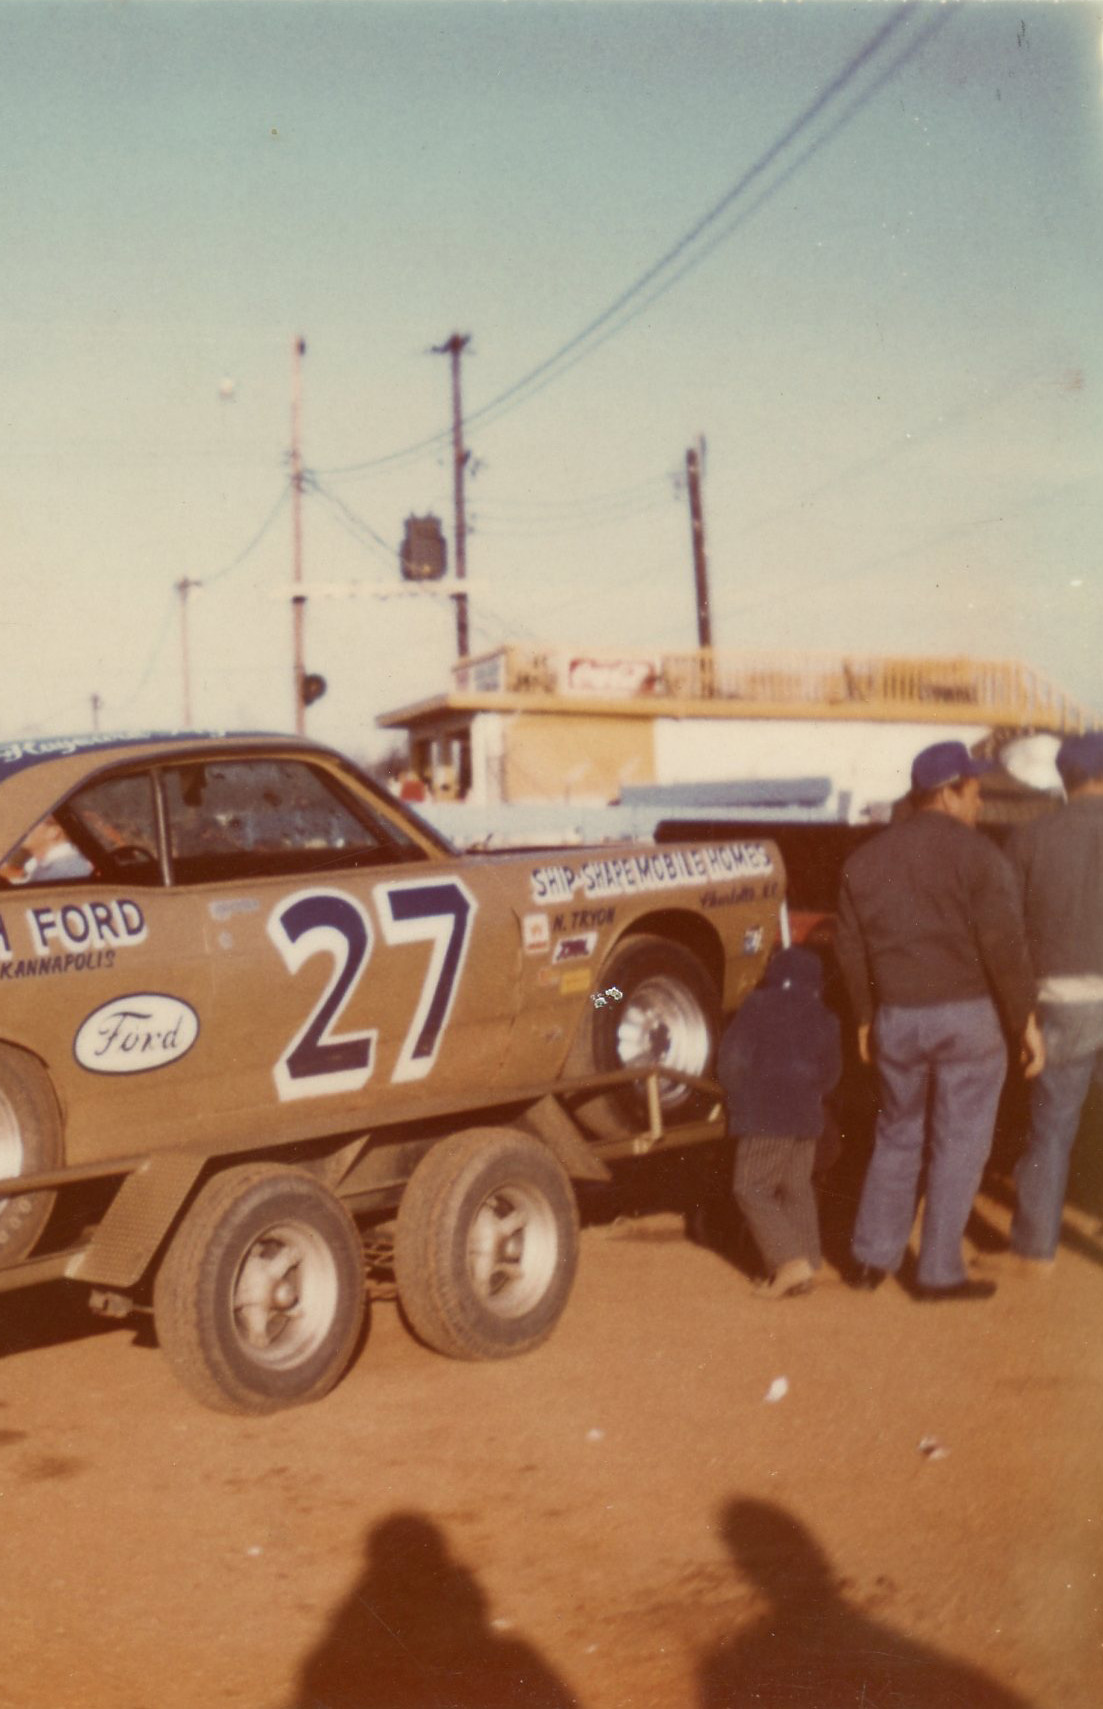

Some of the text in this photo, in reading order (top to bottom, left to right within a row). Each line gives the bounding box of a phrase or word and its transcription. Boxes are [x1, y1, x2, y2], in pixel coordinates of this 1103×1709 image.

[634, 848, 707, 894] MOBILE
[706, 842, 773, 883] HOMES
[27, 898, 148, 956] FORD
[571, 906, 616, 931] TRYON
[266, 875, 479, 1102] 27
[93, 1010, 184, 1057] Ford
